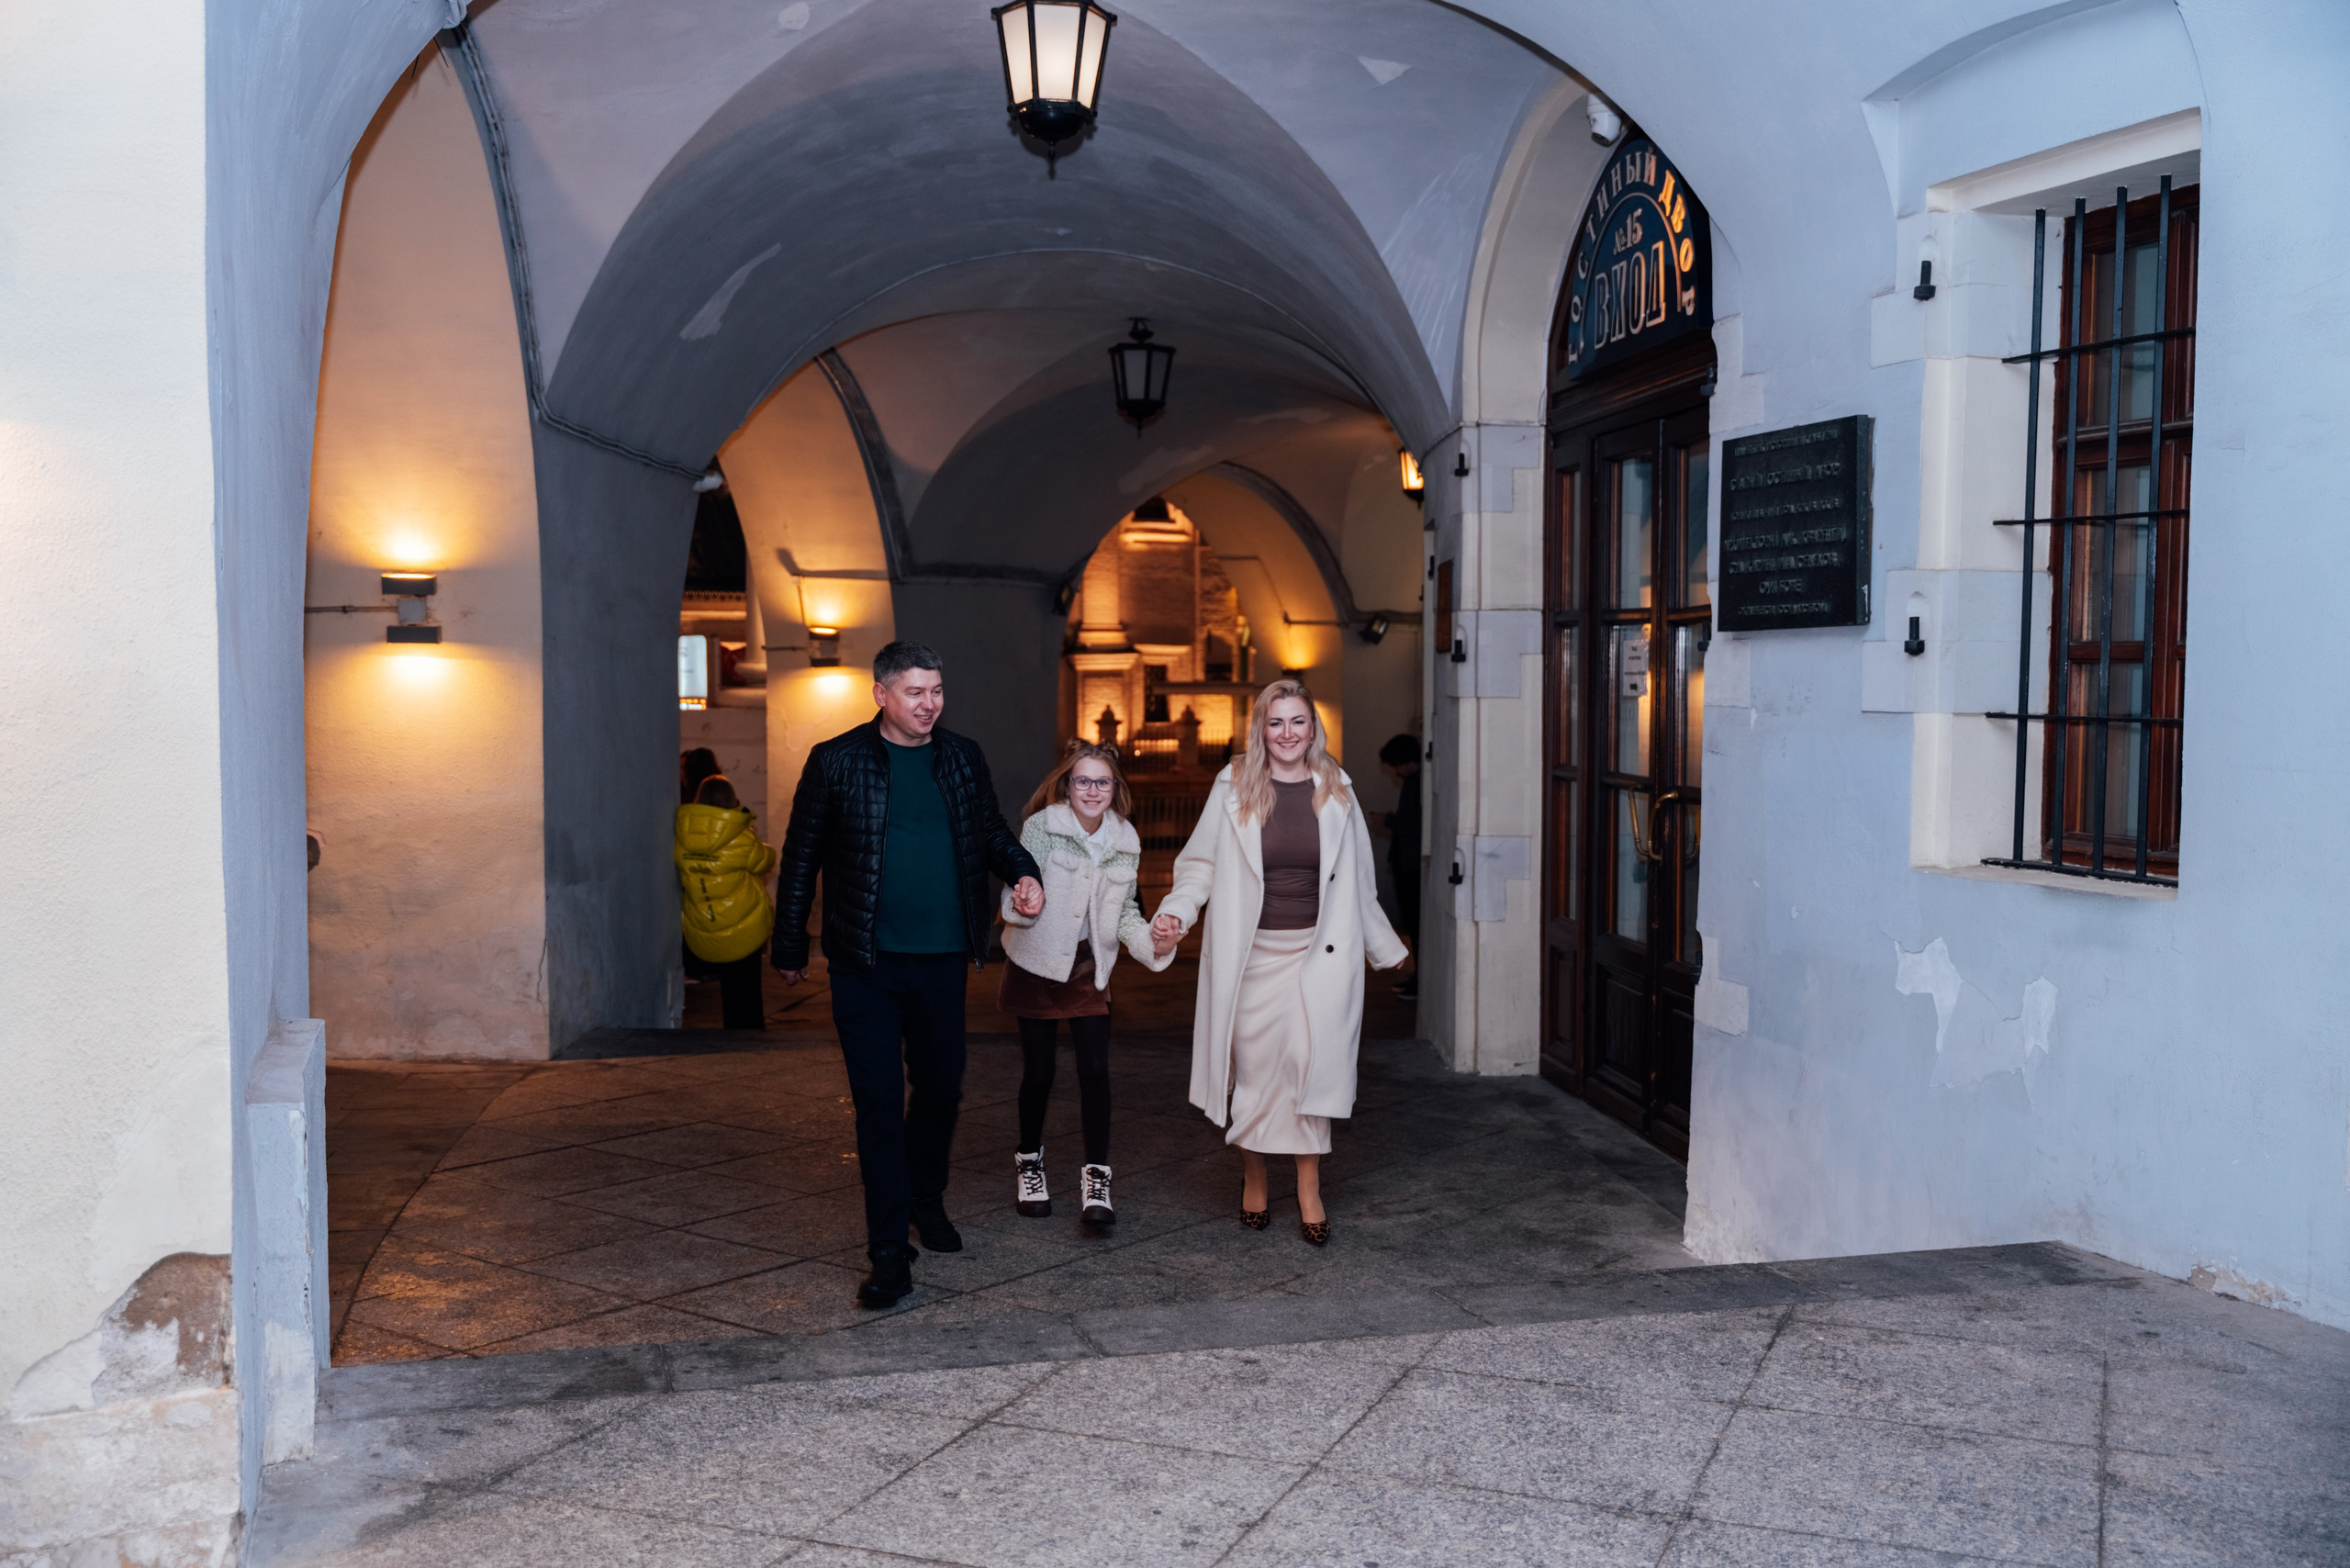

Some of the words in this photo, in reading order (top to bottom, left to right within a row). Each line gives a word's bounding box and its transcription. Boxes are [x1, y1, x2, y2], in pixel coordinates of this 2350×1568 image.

[1568, 145, 1657, 364] ГОСТИНЫЙ
[1658, 170, 1695, 316] ДВОР
[1613, 208, 1642, 255] №15
[1595, 241, 1666, 350] ВХОД
